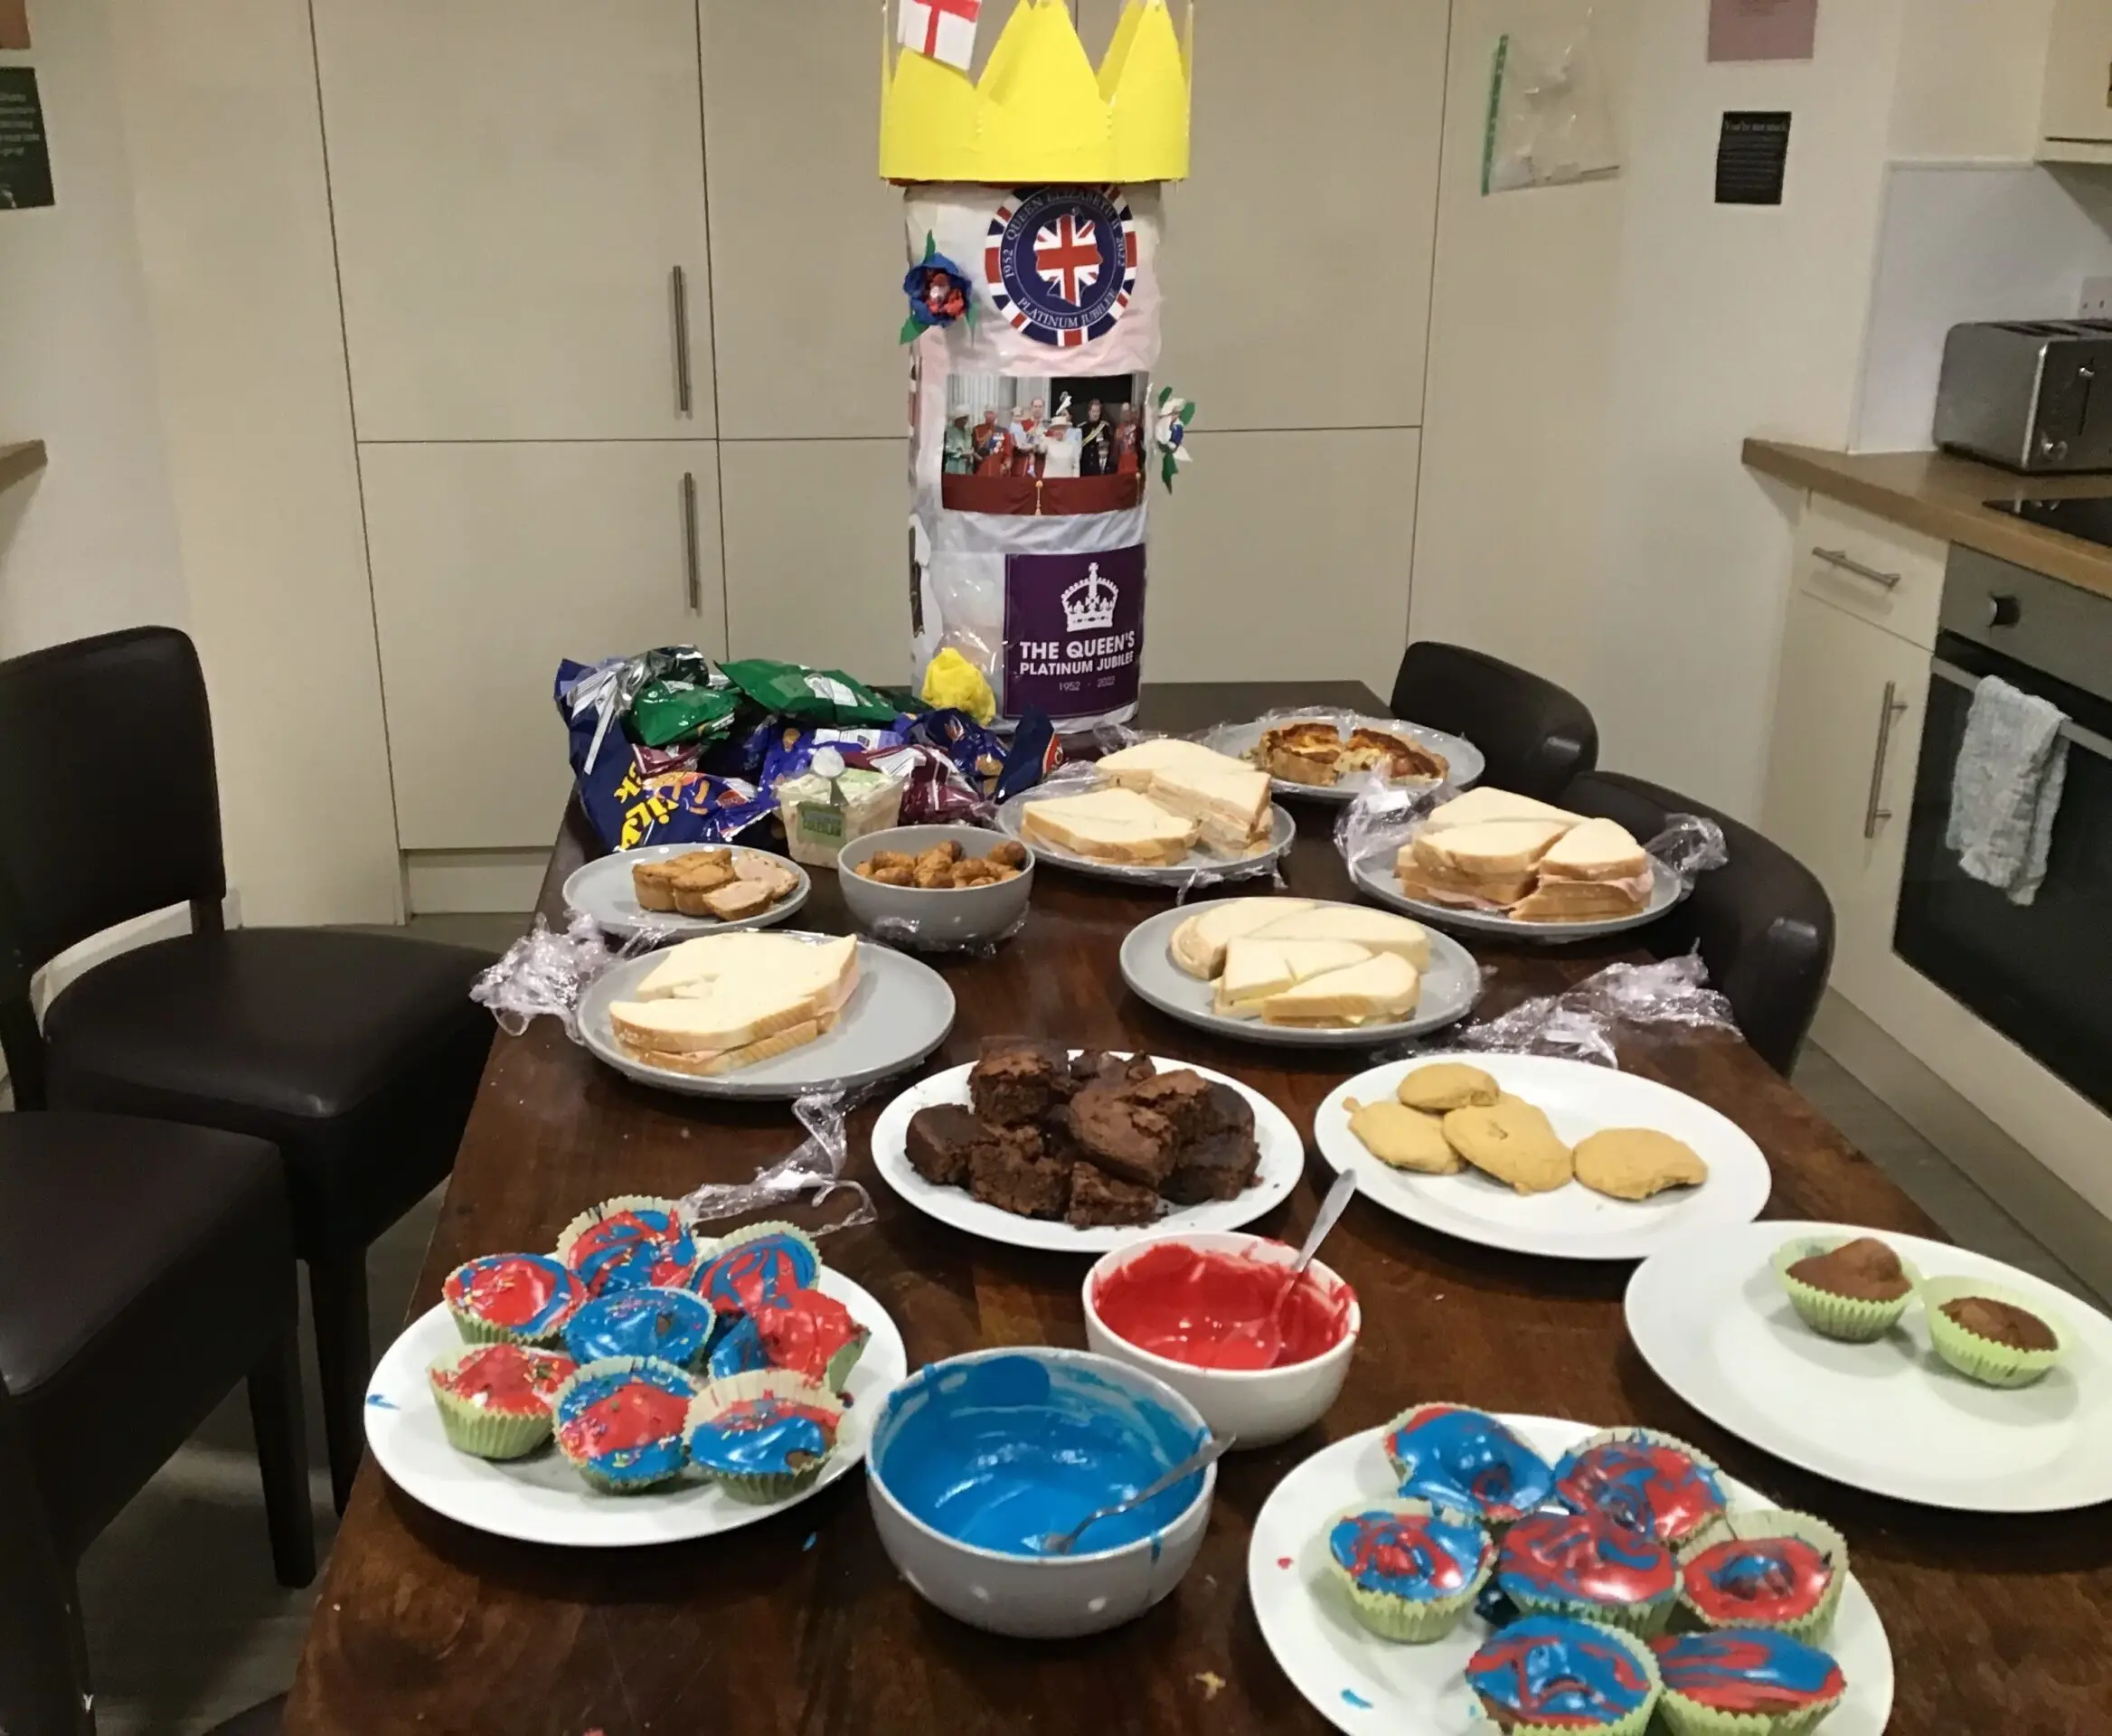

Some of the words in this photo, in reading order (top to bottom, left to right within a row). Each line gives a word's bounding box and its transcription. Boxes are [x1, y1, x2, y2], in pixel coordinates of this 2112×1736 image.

[1047, 188, 1113, 218] ELIZABETH
[1006, 196, 1044, 241] QUEEN
[1003, 249, 1014, 278] 1952
[1018, 297, 1079, 328] PLATINUM
[1081, 288, 1117, 326] JUBILEE
[1019, 641, 1060, 659] THE
[1066, 630, 1136, 659] QUEEN'S
[1019, 660, 1093, 675] PLATINUM
[1096, 650, 1135, 672] JUBILEE
[1059, 680, 1081, 692] 1952
